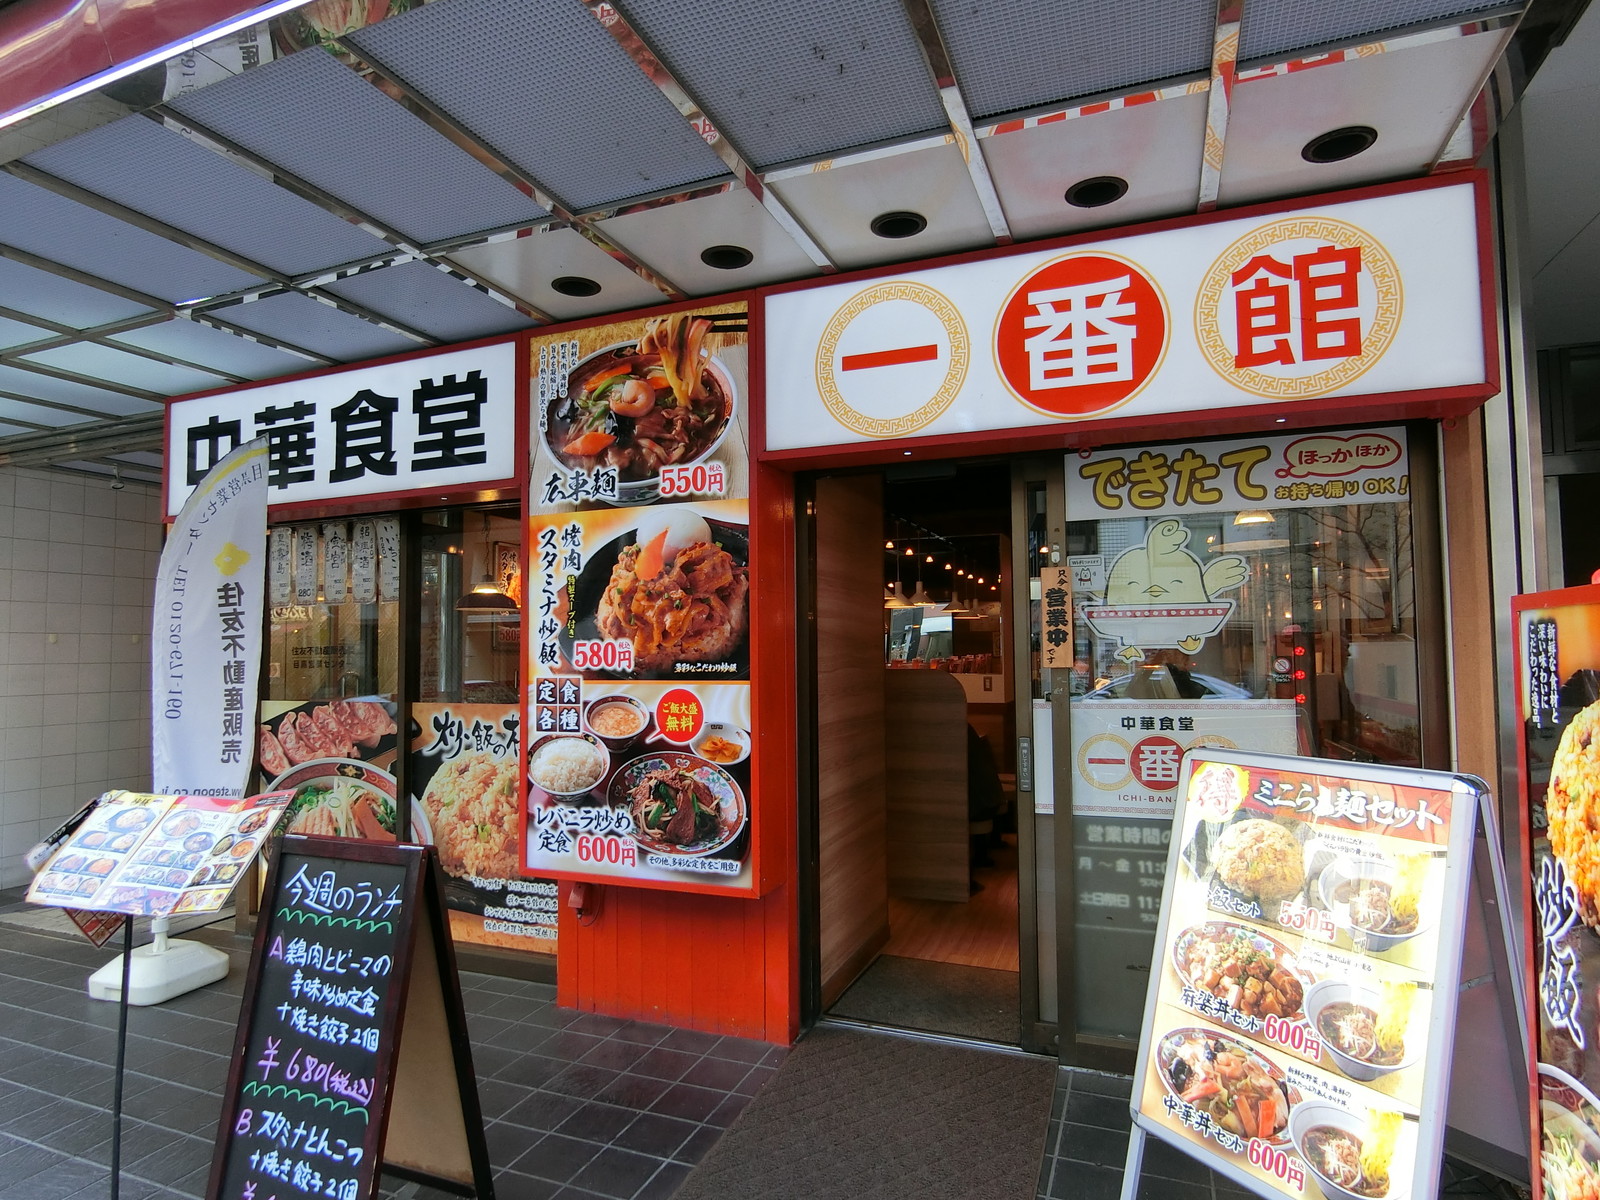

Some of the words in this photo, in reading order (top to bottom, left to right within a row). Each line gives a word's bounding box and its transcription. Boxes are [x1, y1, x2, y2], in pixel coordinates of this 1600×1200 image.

[842, 246, 1362, 391] 一番館
[186, 369, 488, 489] 中華食堂
[542, 469, 616, 504] 広東麺
[1079, 450, 1272, 511] できたて
[561, 523, 581, 571] 焼肉
[538, 529, 559, 665] スタミナ炒飯
[1538, 623, 1549, 709] 深い味わいに
[1547, 623, 1558, 723] 新鮮な食材と
[662, 702, 698, 714] ご飯大盛
[665, 715, 695, 733] 無料
[1121, 716, 1194, 731] 中華食堂
[536, 807, 631, 832] レバニラ炒め
[538, 829, 572, 853] 定食
[286, 863, 402, 918] 今週のランチ
[1181, 985, 1259, 1033] 麻婆丼セット
[1163, 1095, 1244, 1153] 中華丼セット
